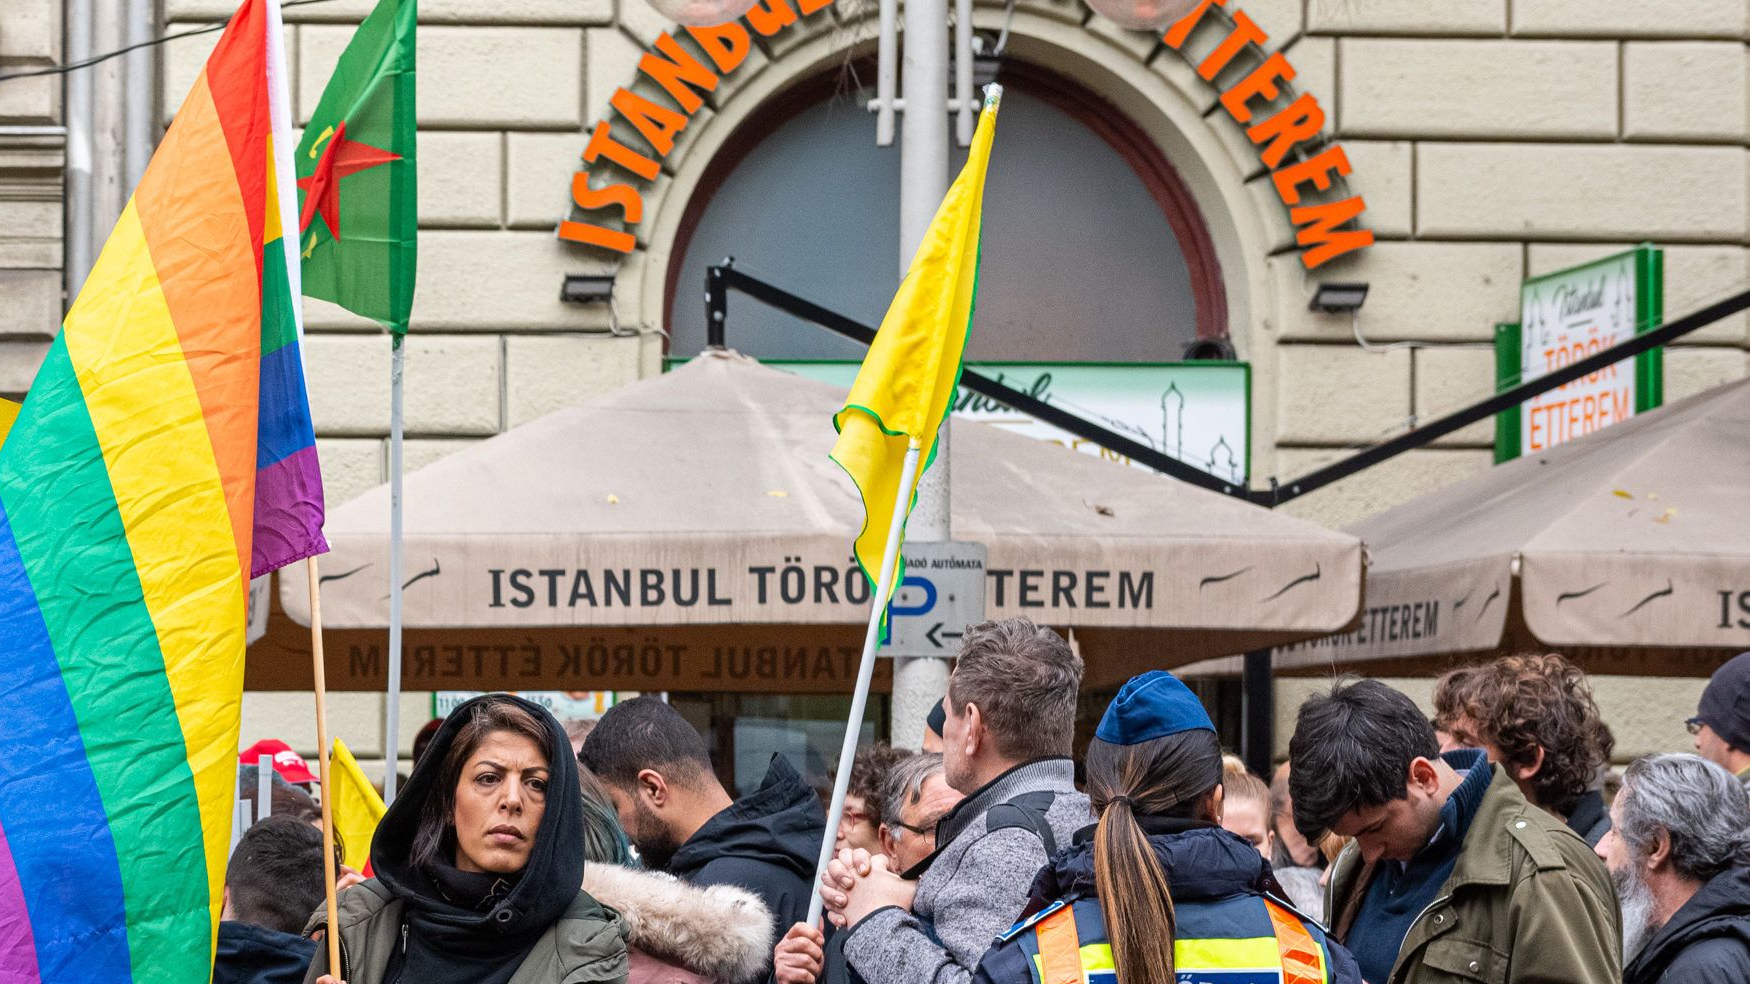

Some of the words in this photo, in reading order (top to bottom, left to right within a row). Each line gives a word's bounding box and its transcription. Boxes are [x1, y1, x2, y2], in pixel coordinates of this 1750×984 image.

[488, 567, 733, 608] ISTANBUL
[749, 556, 873, 605] TÖRÖ
[986, 568, 1154, 609] TEREM
